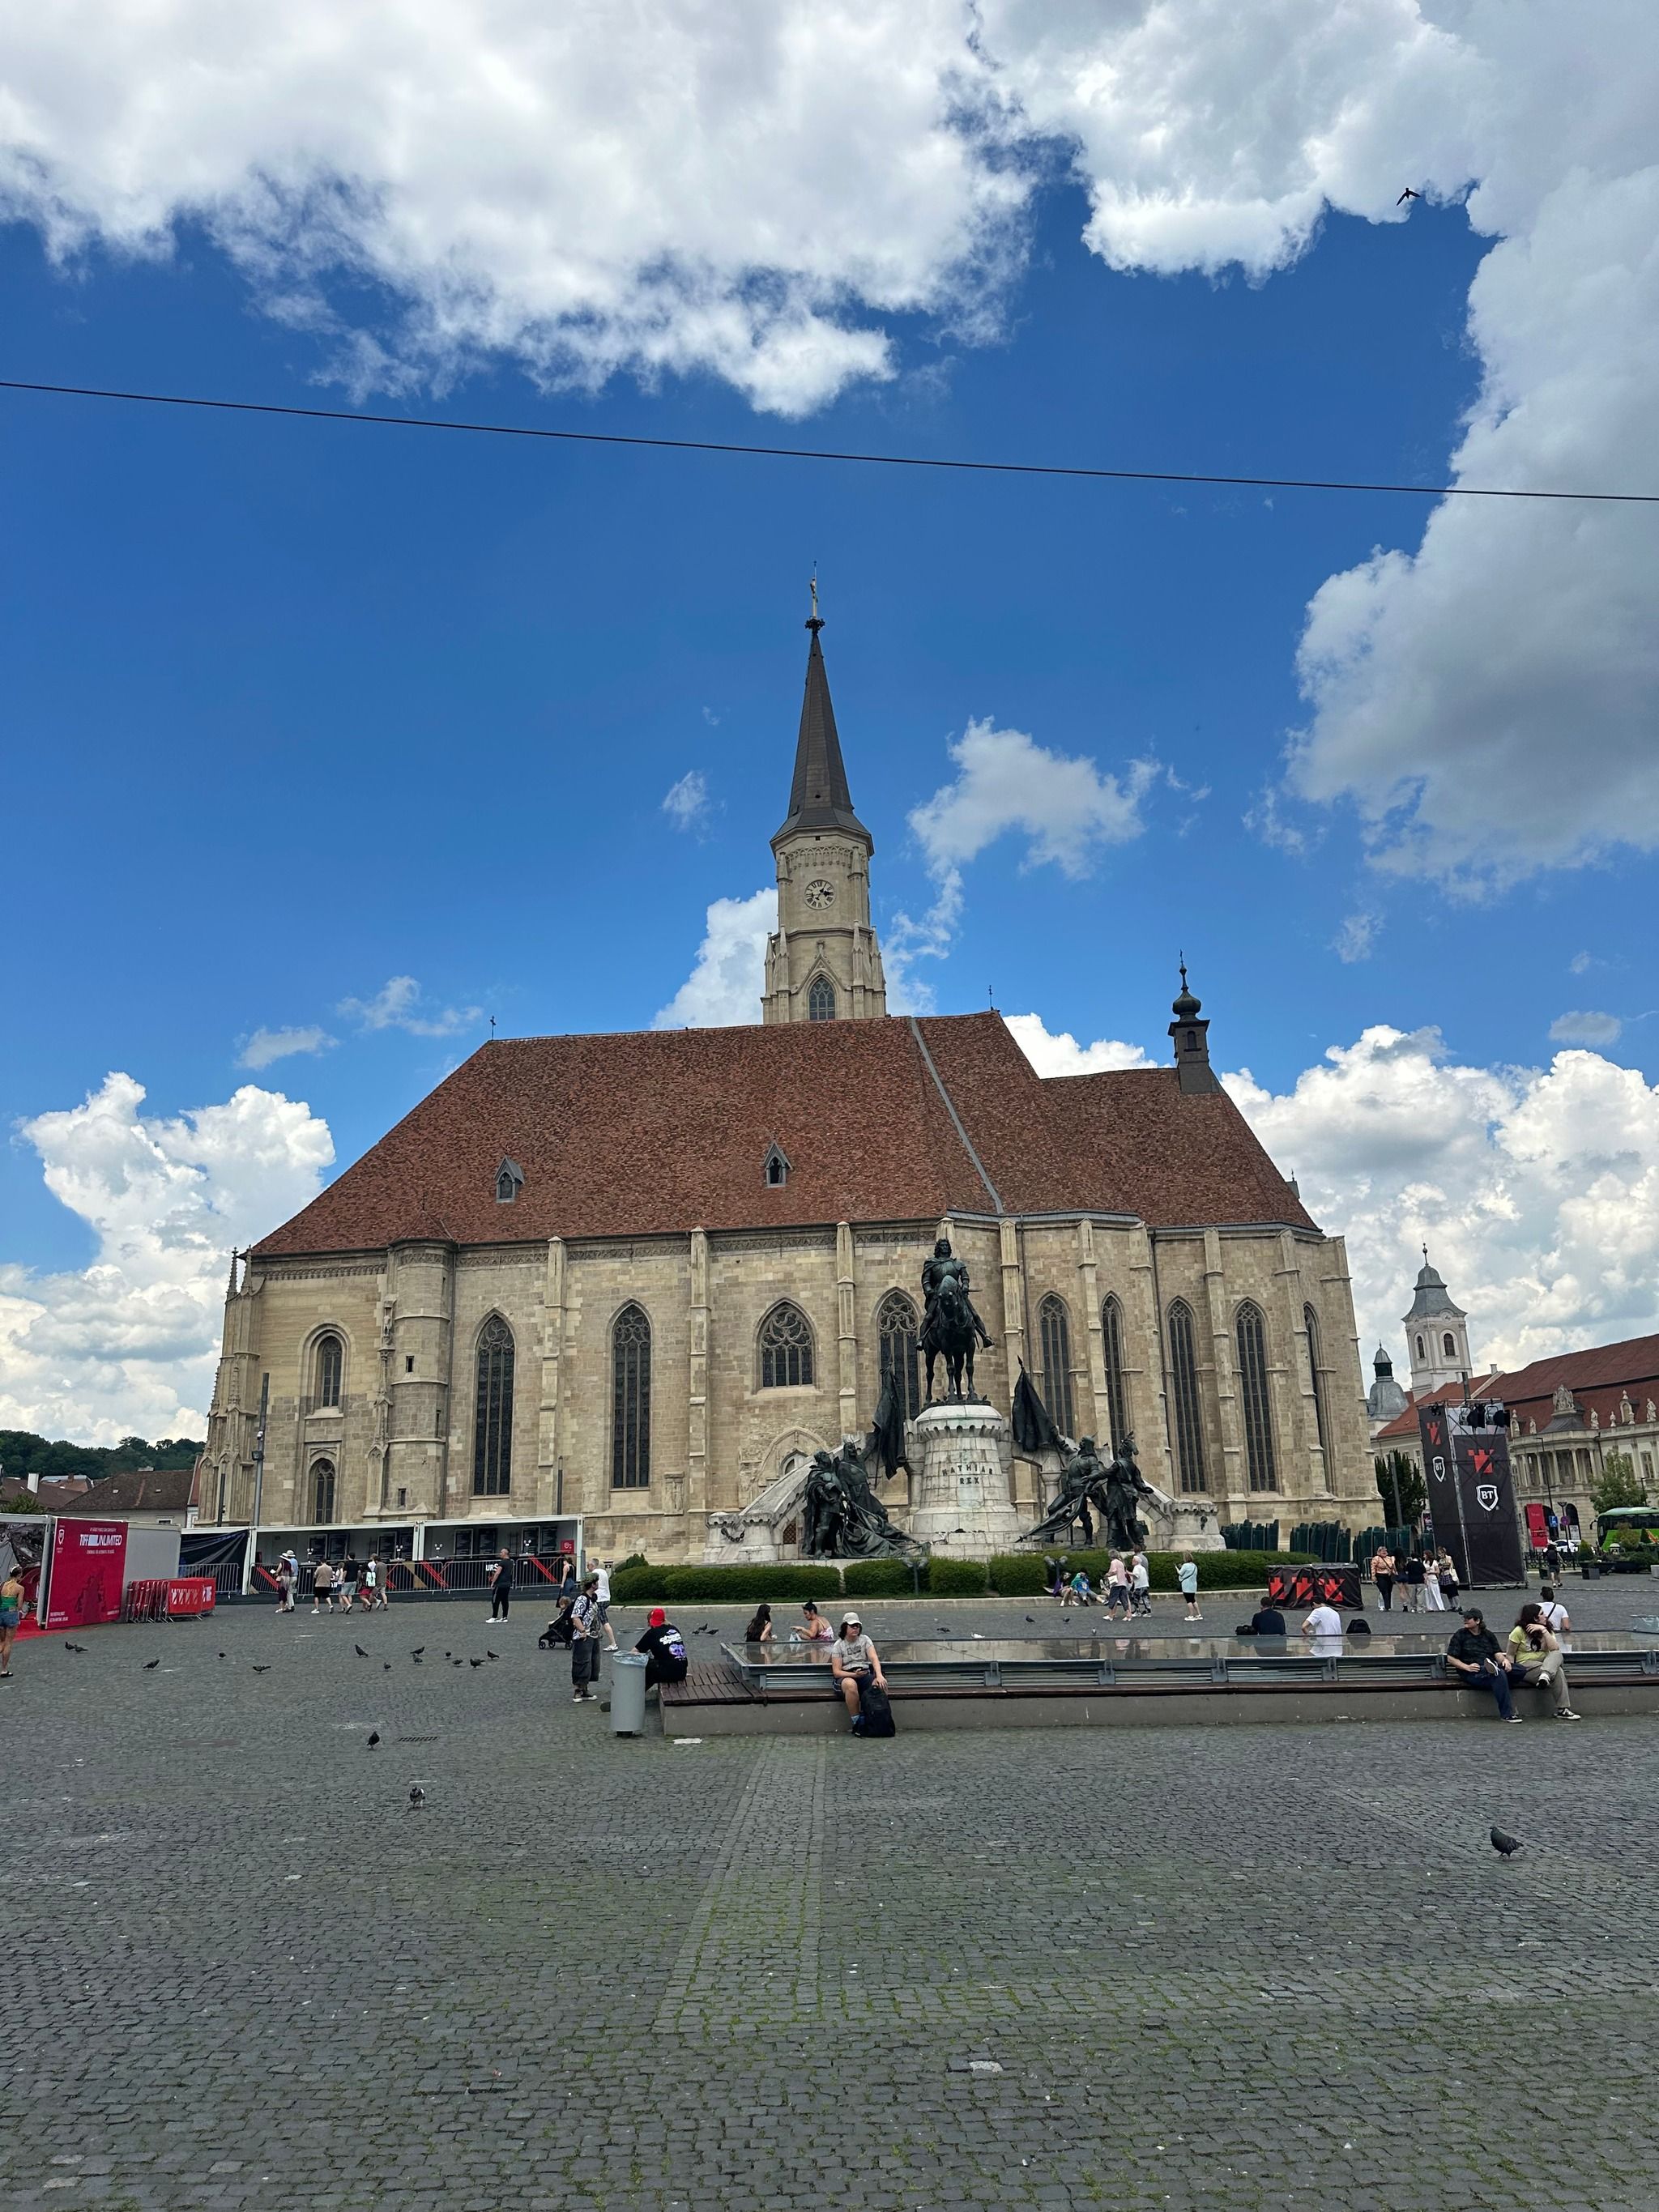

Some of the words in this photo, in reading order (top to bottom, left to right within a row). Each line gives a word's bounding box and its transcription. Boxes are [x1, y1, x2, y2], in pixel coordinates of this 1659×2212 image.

[1435, 1462, 1443, 1471] BT
[959, 1477, 979, 1485] REX
[1481, 1490, 1494, 1500] BT
[485, 1562, 499, 1572] URS
